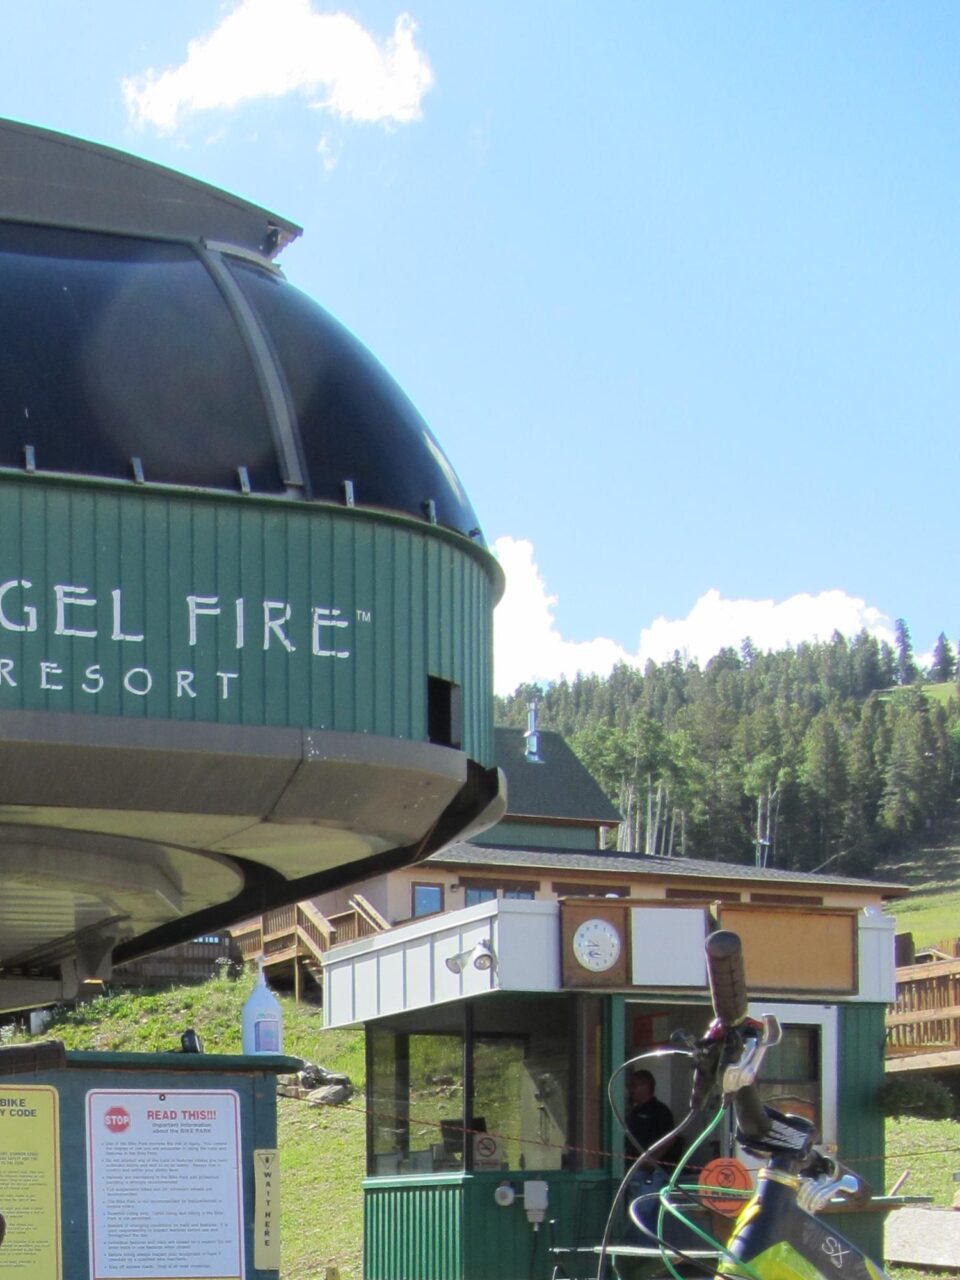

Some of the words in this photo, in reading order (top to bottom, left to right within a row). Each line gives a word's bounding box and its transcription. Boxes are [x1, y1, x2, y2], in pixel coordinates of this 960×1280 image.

[186, 594, 350, 658] FIRE
[0, 1098, 27, 1107] BIKE
[9, 1109, 37, 1117] CODE
[147, 1110, 178, 1120] READ
[181, 1110, 217, 1120] THIS!!!
[104, 1115, 130, 1125] STOP
[263, 1172, 273, 1206] WAIT
